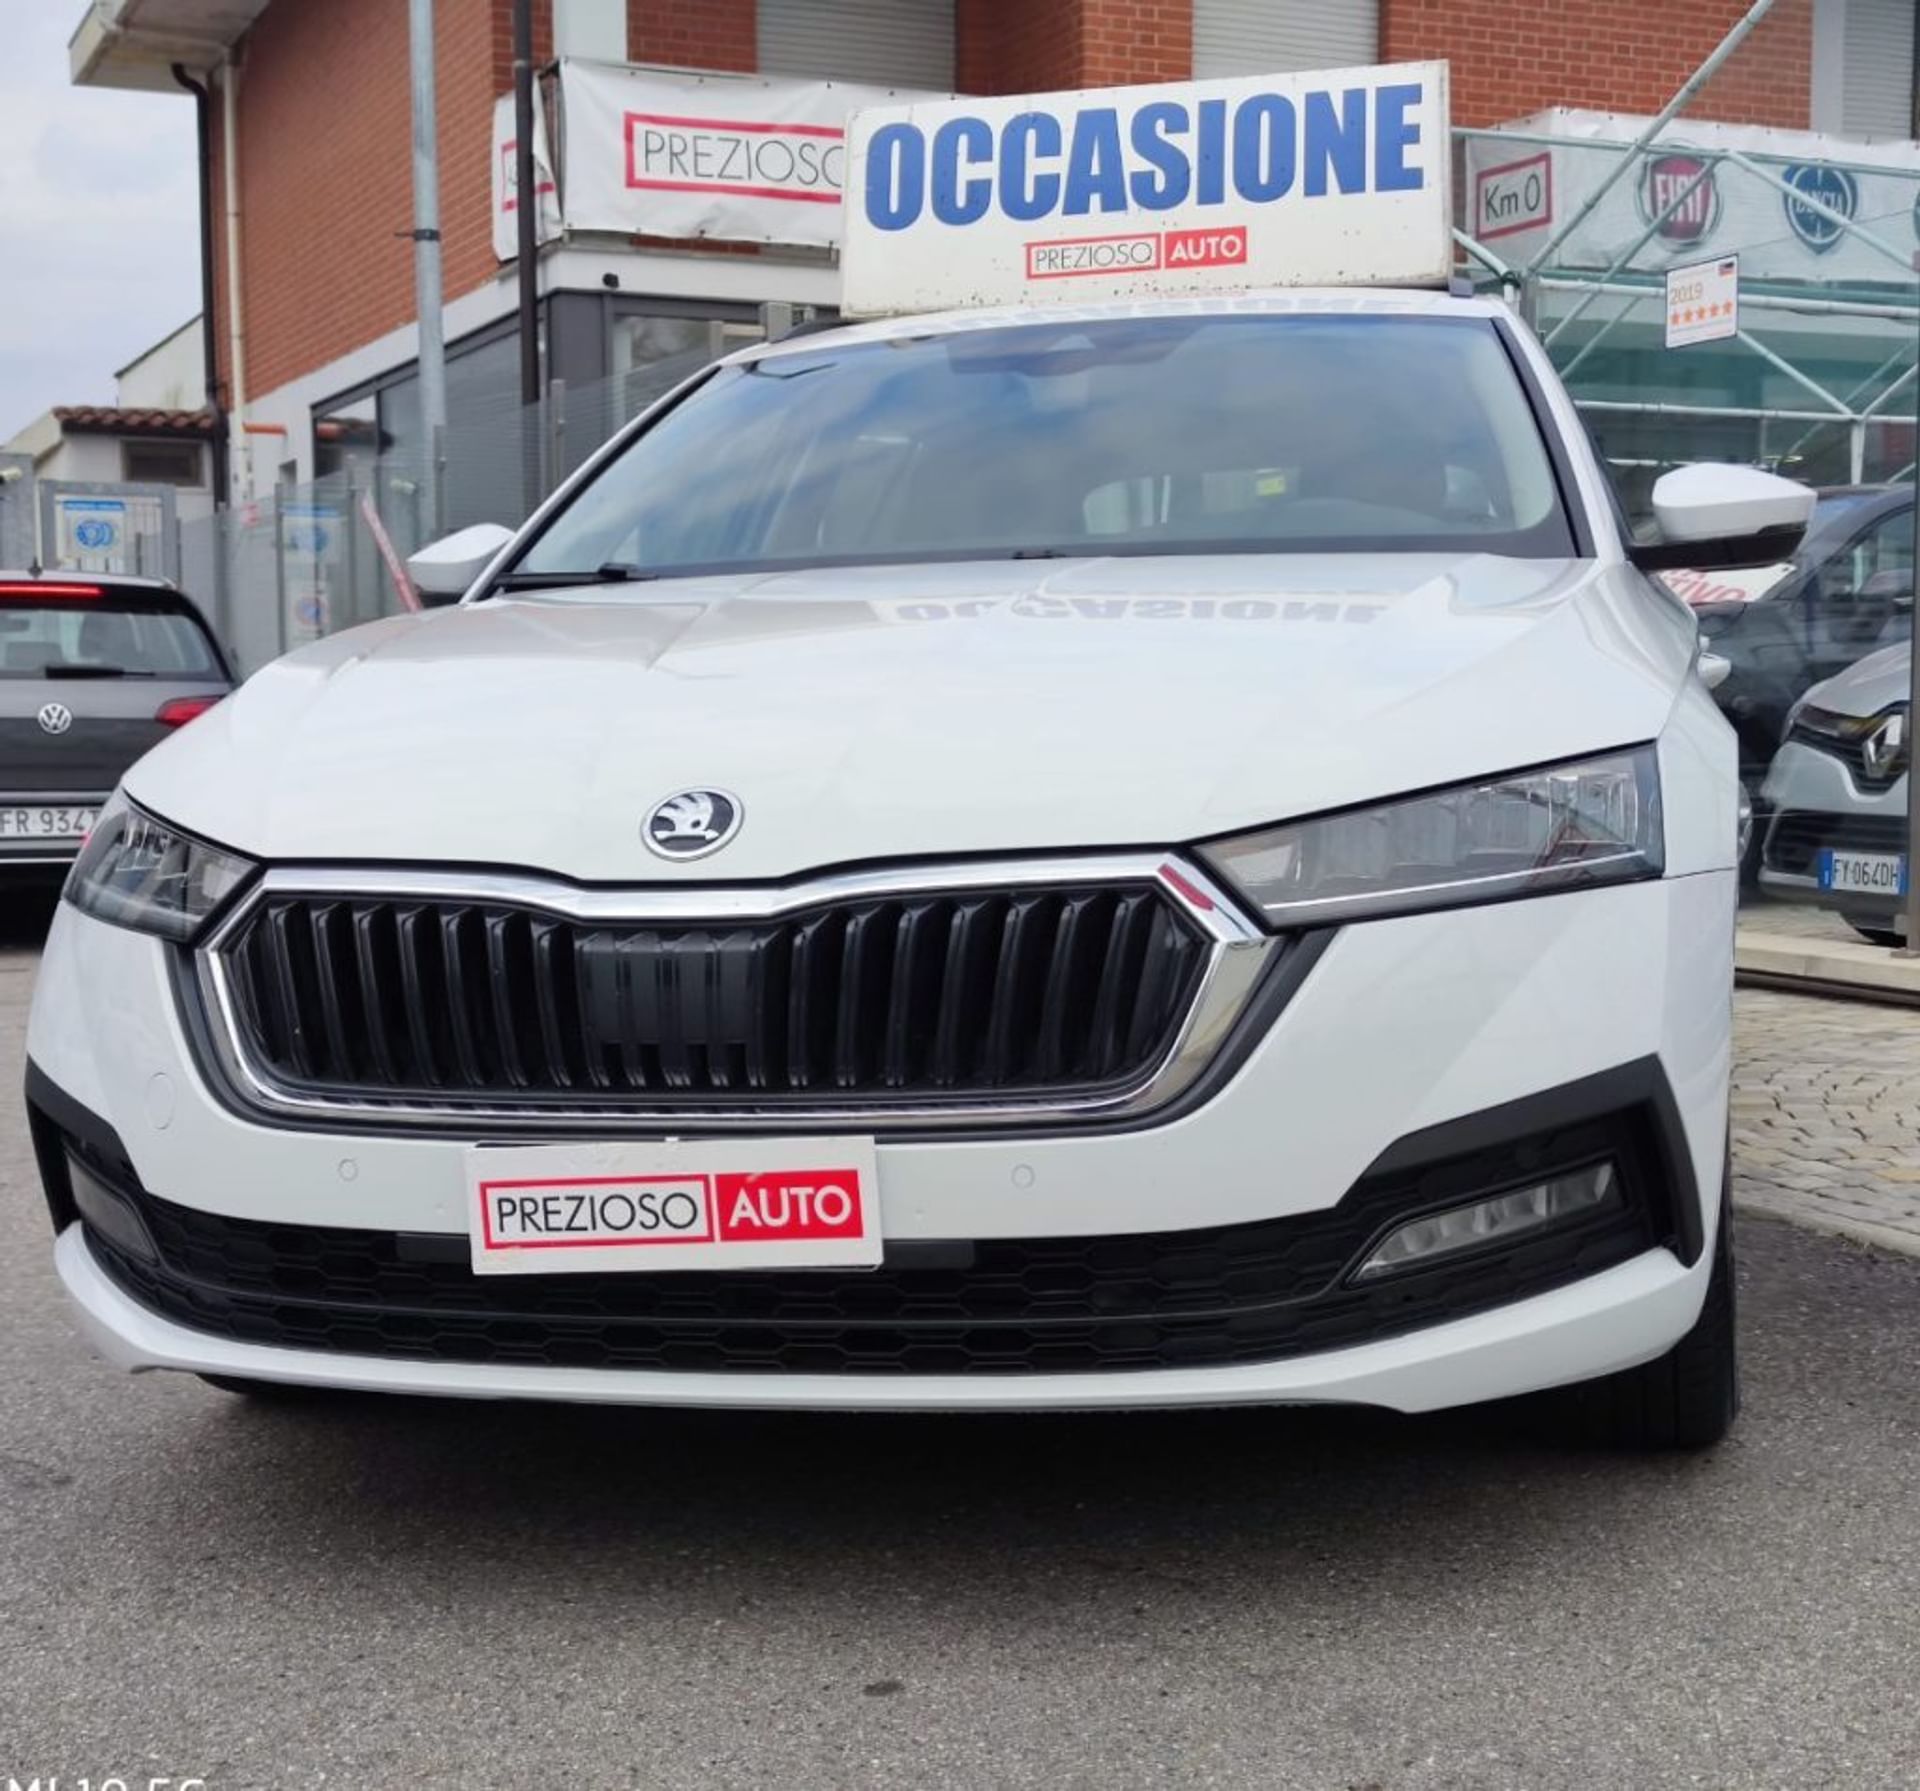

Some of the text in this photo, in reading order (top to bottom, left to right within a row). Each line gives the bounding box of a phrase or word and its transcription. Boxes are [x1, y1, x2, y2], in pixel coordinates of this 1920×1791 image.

[865, 83, 1424, 231] OCCASIONE
[1485, 183, 1519, 222] Km
[1655, 173, 1702, 224] FIAT
[1035, 234, 1242, 271] PREZIOSO AUTO
[1669, 281, 1704, 305] 2019
[496, 1185, 852, 1233] PREZIOSO AUTO
